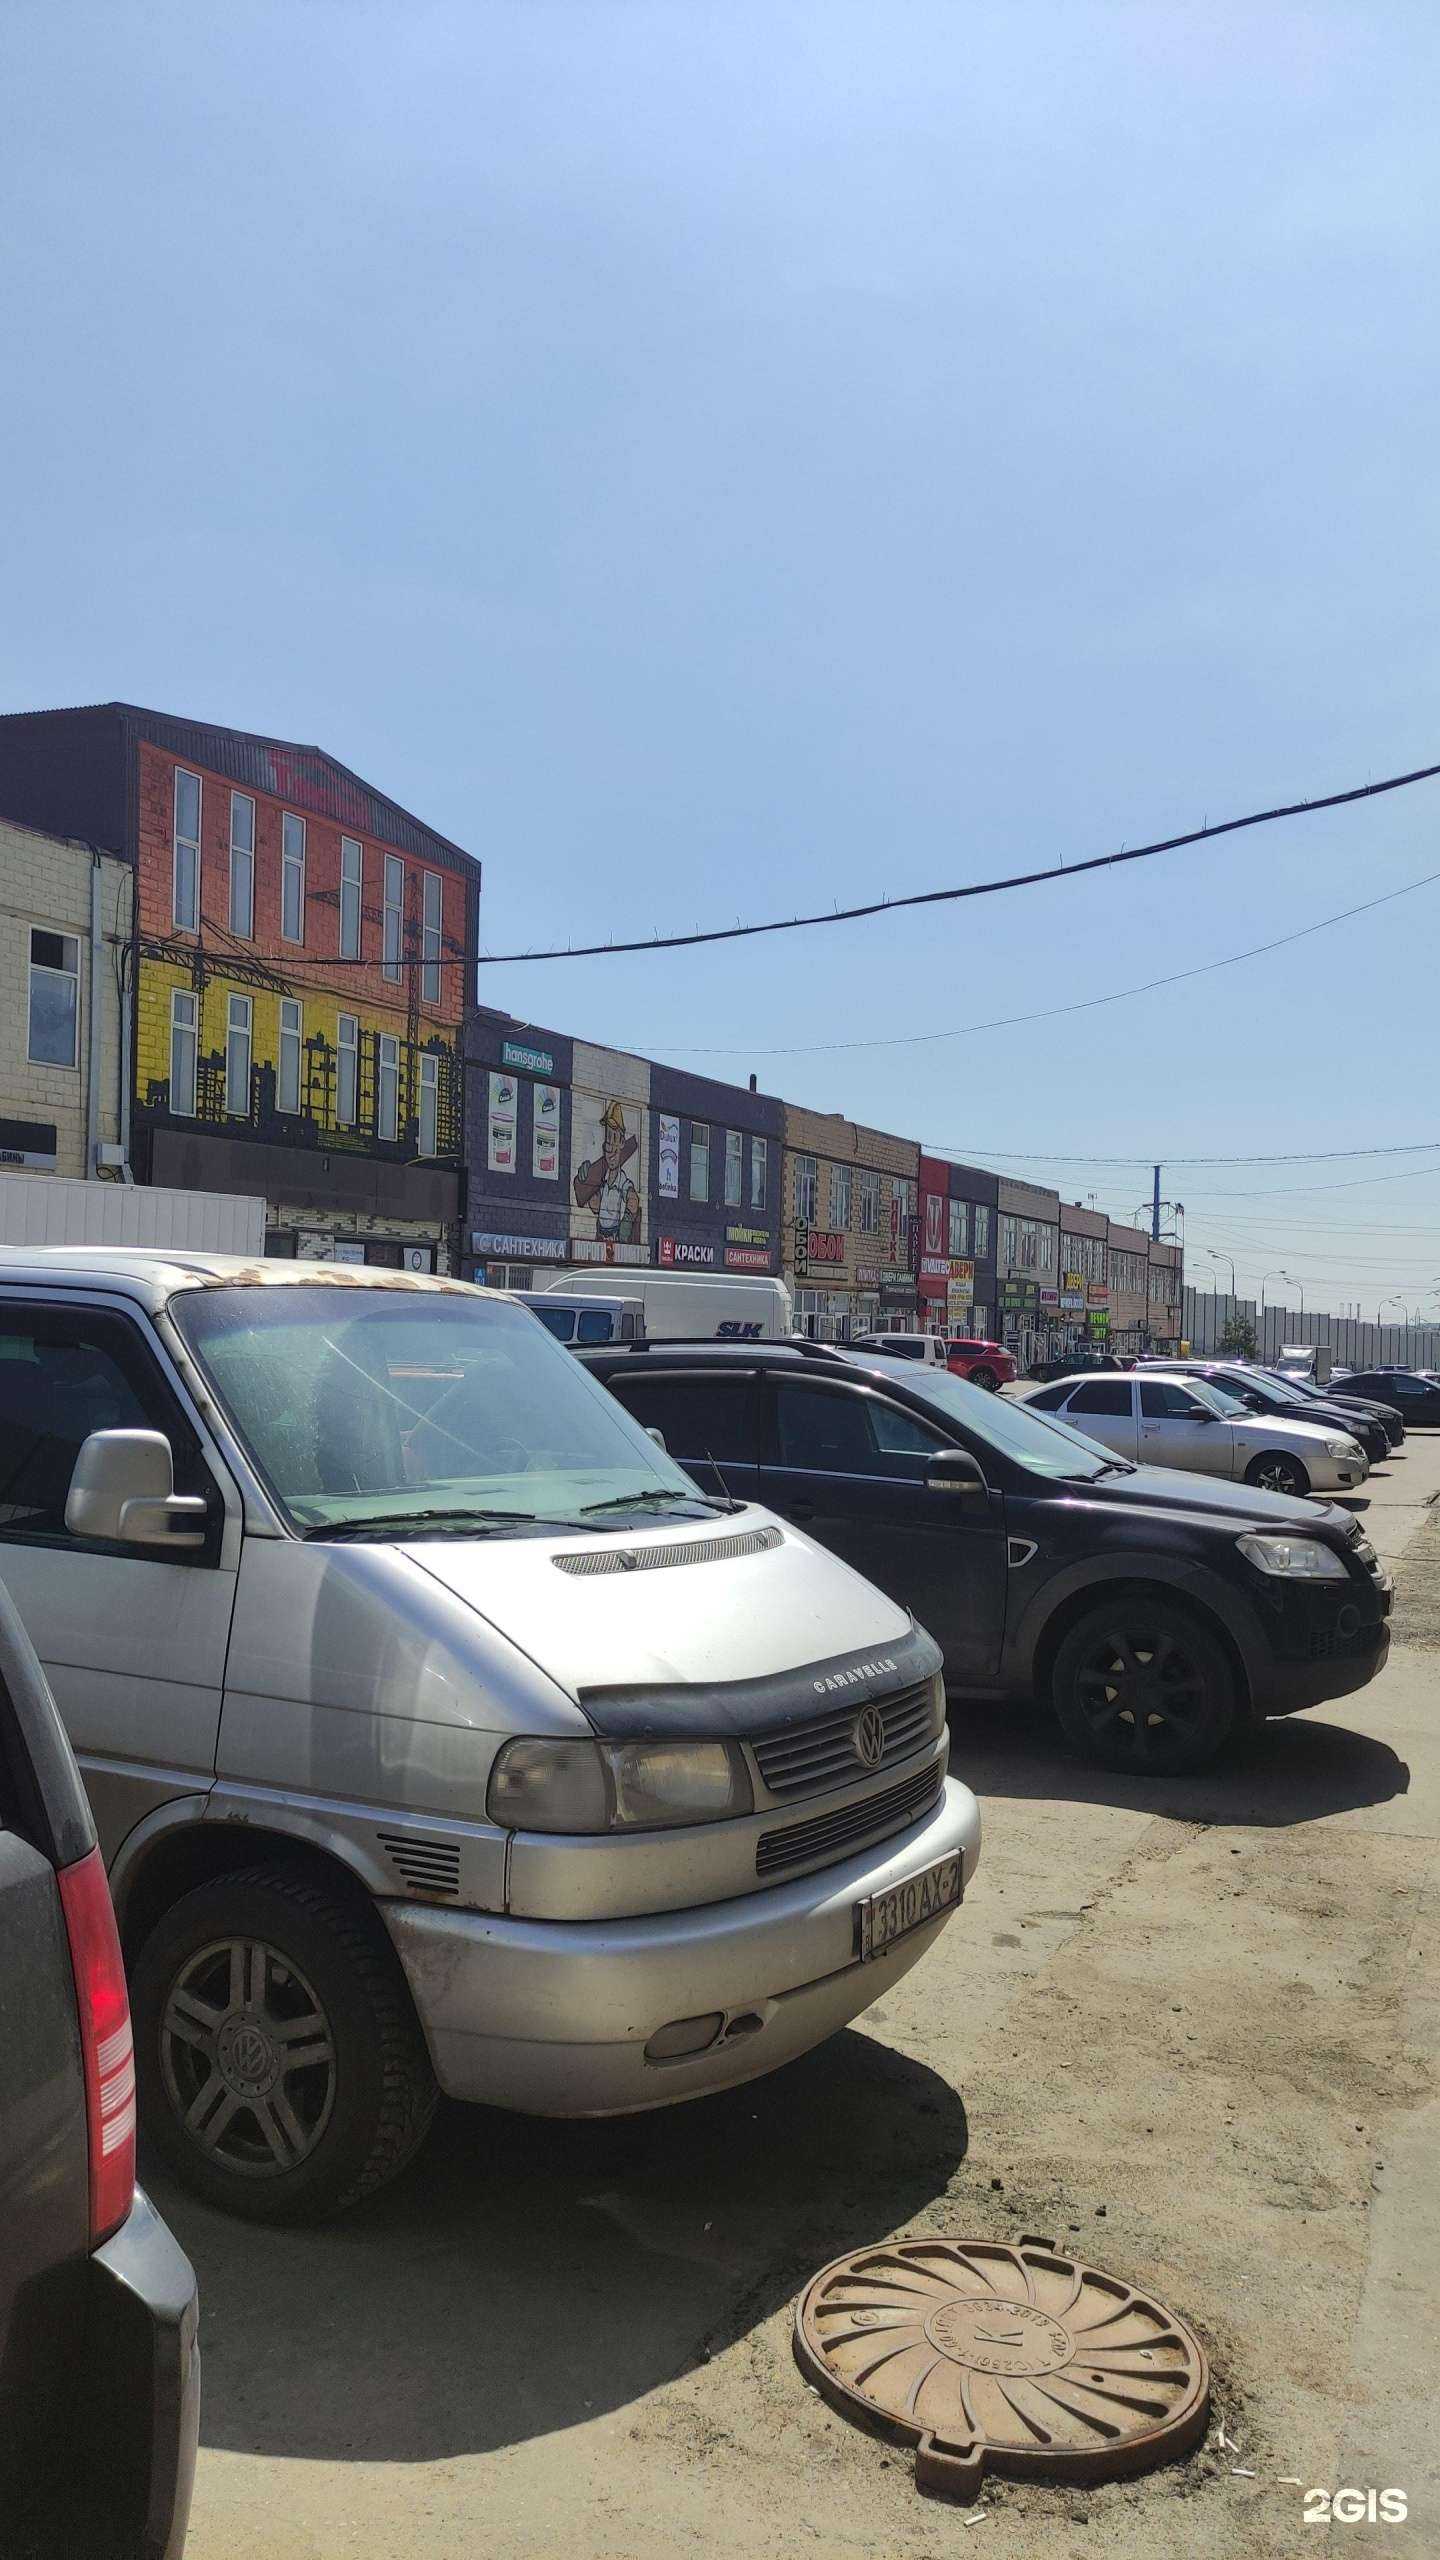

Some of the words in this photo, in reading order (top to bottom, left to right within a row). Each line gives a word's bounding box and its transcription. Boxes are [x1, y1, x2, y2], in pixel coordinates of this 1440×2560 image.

[504, 1042, 553, 1070] hansgrohe
[493, 1236, 565, 1258] САНТЕХНИКА
[674, 1244, 714, 1263] КРАСКИ
[728, 1251, 769, 1266] САНТЕХНИКА
[795, 1217, 807, 1274] ОБОИ
[809, 1233, 845, 1260] ОБОИ
[813, 1659, 898, 1693] CARAVELLE
